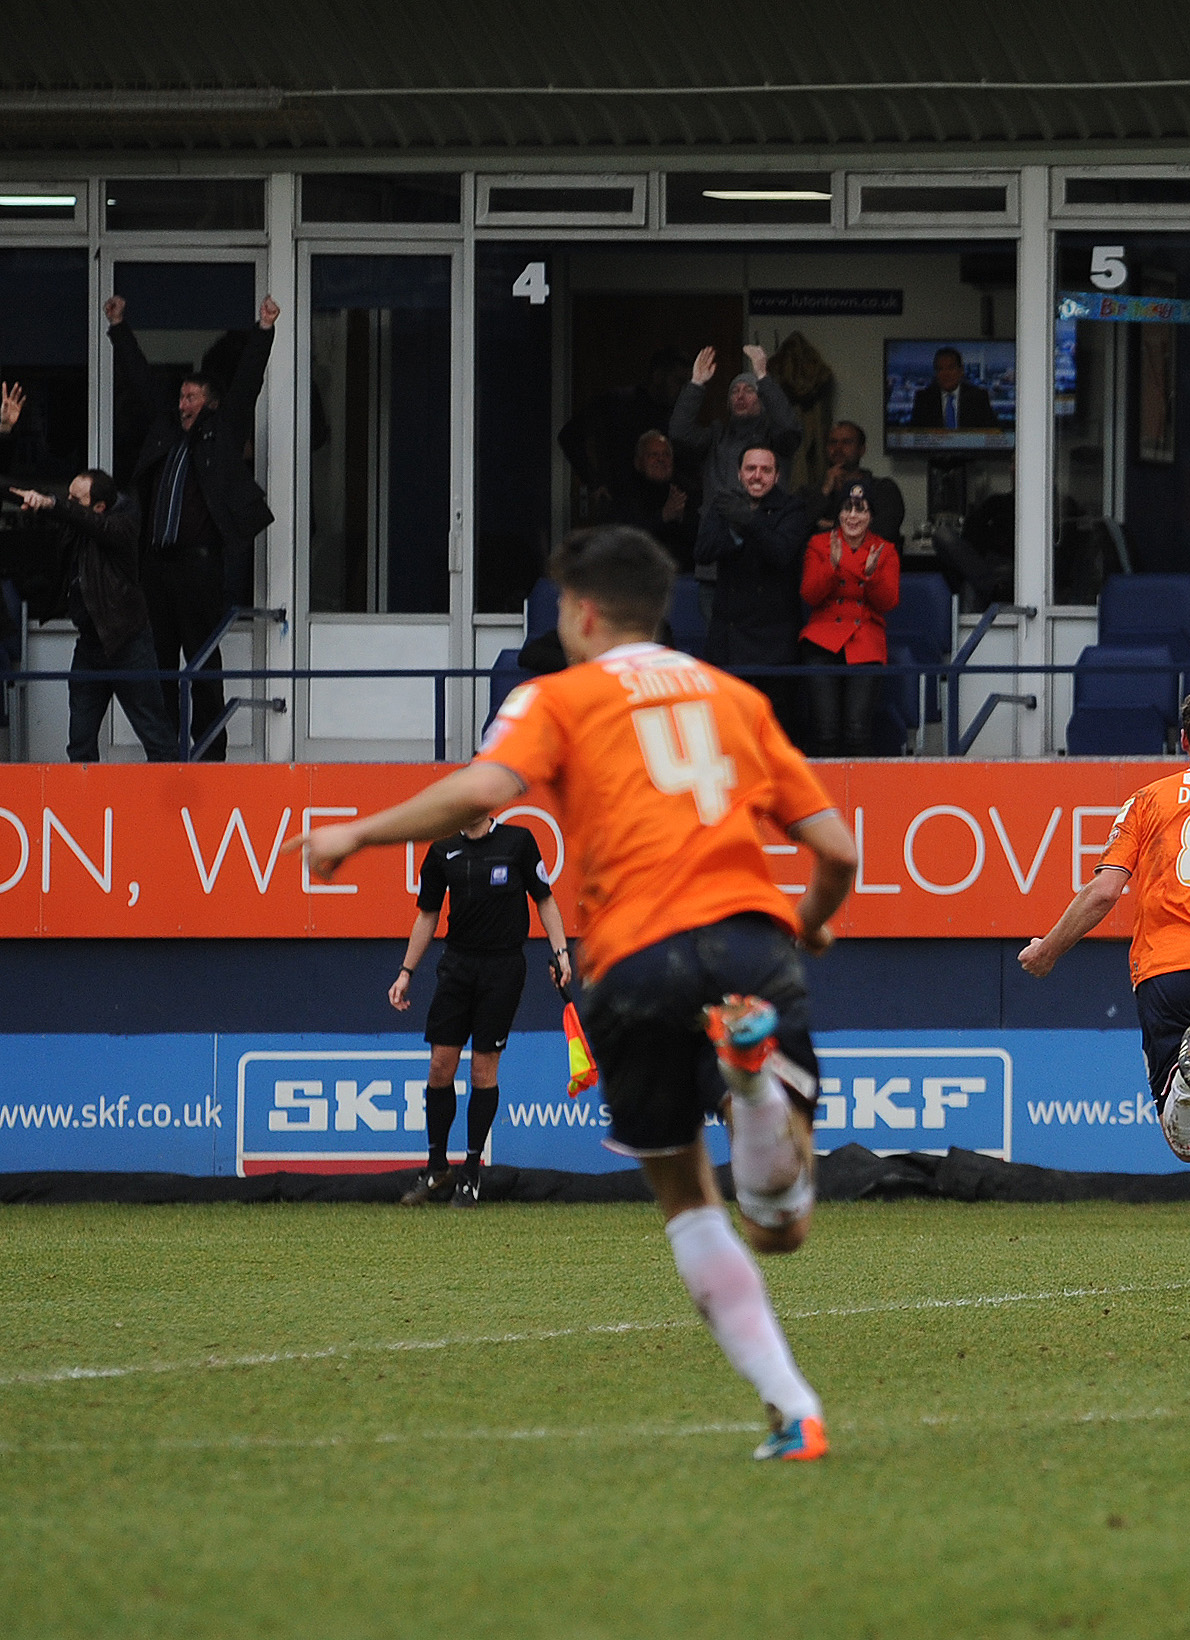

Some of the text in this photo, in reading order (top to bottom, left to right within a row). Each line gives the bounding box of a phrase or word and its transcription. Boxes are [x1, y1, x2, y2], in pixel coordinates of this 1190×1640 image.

[511, 261, 550, 304] 4
[1090, 246, 1128, 289] 5
[631, 700, 738, 826] 4
[181, 807, 358, 894] WE
[855, 804, 1130, 895] LOVE
